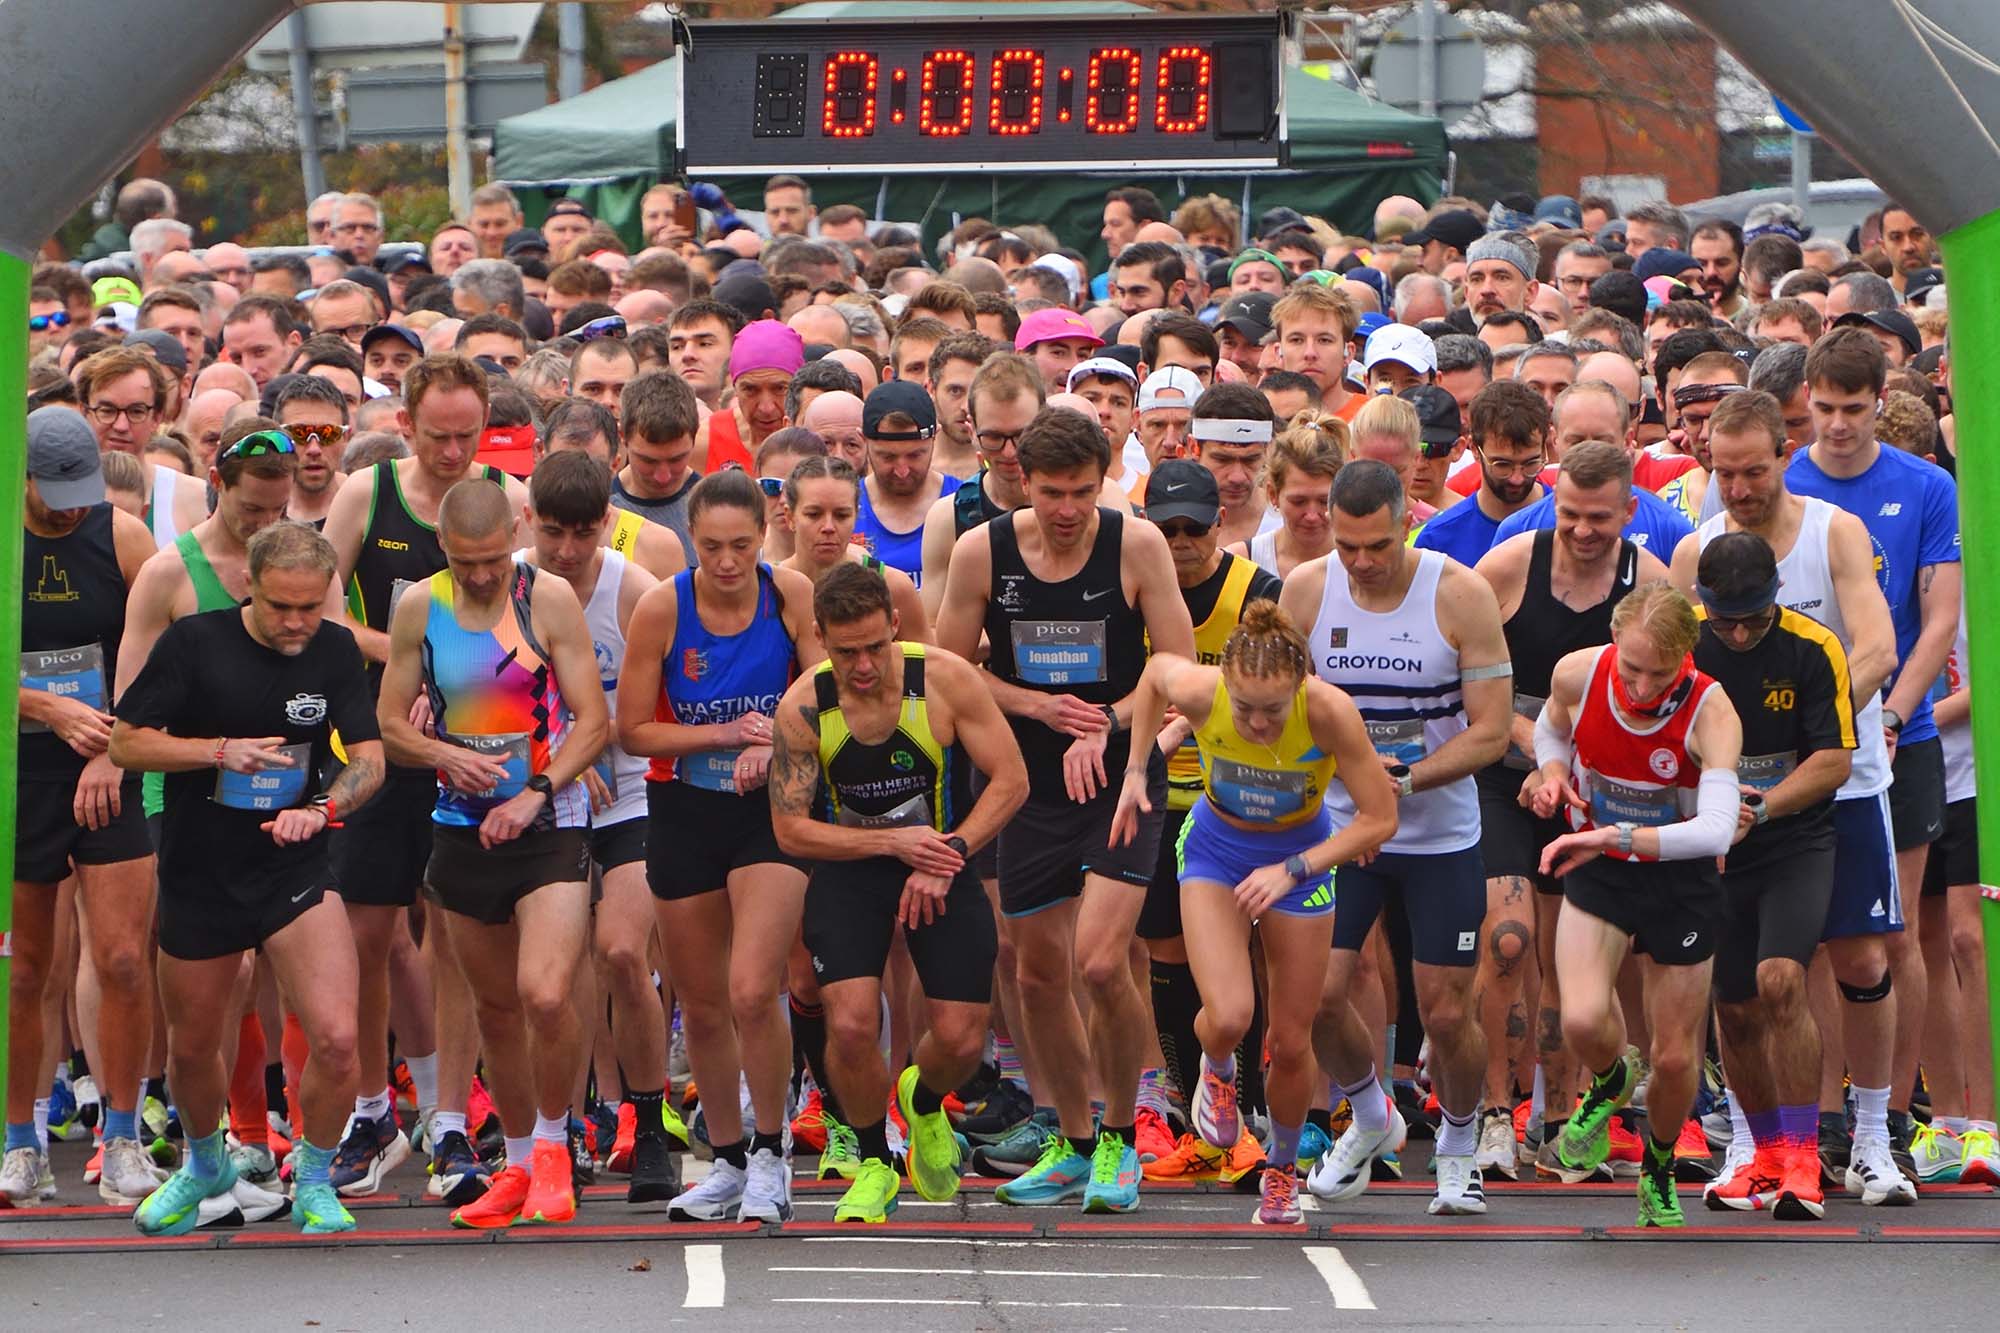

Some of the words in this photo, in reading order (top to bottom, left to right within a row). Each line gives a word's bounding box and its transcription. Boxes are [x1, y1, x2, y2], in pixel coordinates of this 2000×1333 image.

[823, 47, 1210, 137] 0:00:00
[1036, 624, 1081, 637] pico
[40, 652, 82, 669] pico
[1029, 650, 1089, 664] Jonathan
[1326, 656, 1423, 673] CROYDON
[1049, 672, 1069, 683] 136
[1236, 766, 1281, 781] pico
[251, 776, 281, 789] Sam
[884, 775, 927, 789] HERTS
[1610, 784, 1653, 798] pico
[253, 796, 273, 808] 123
[1605, 800, 1662, 818] Matthew
